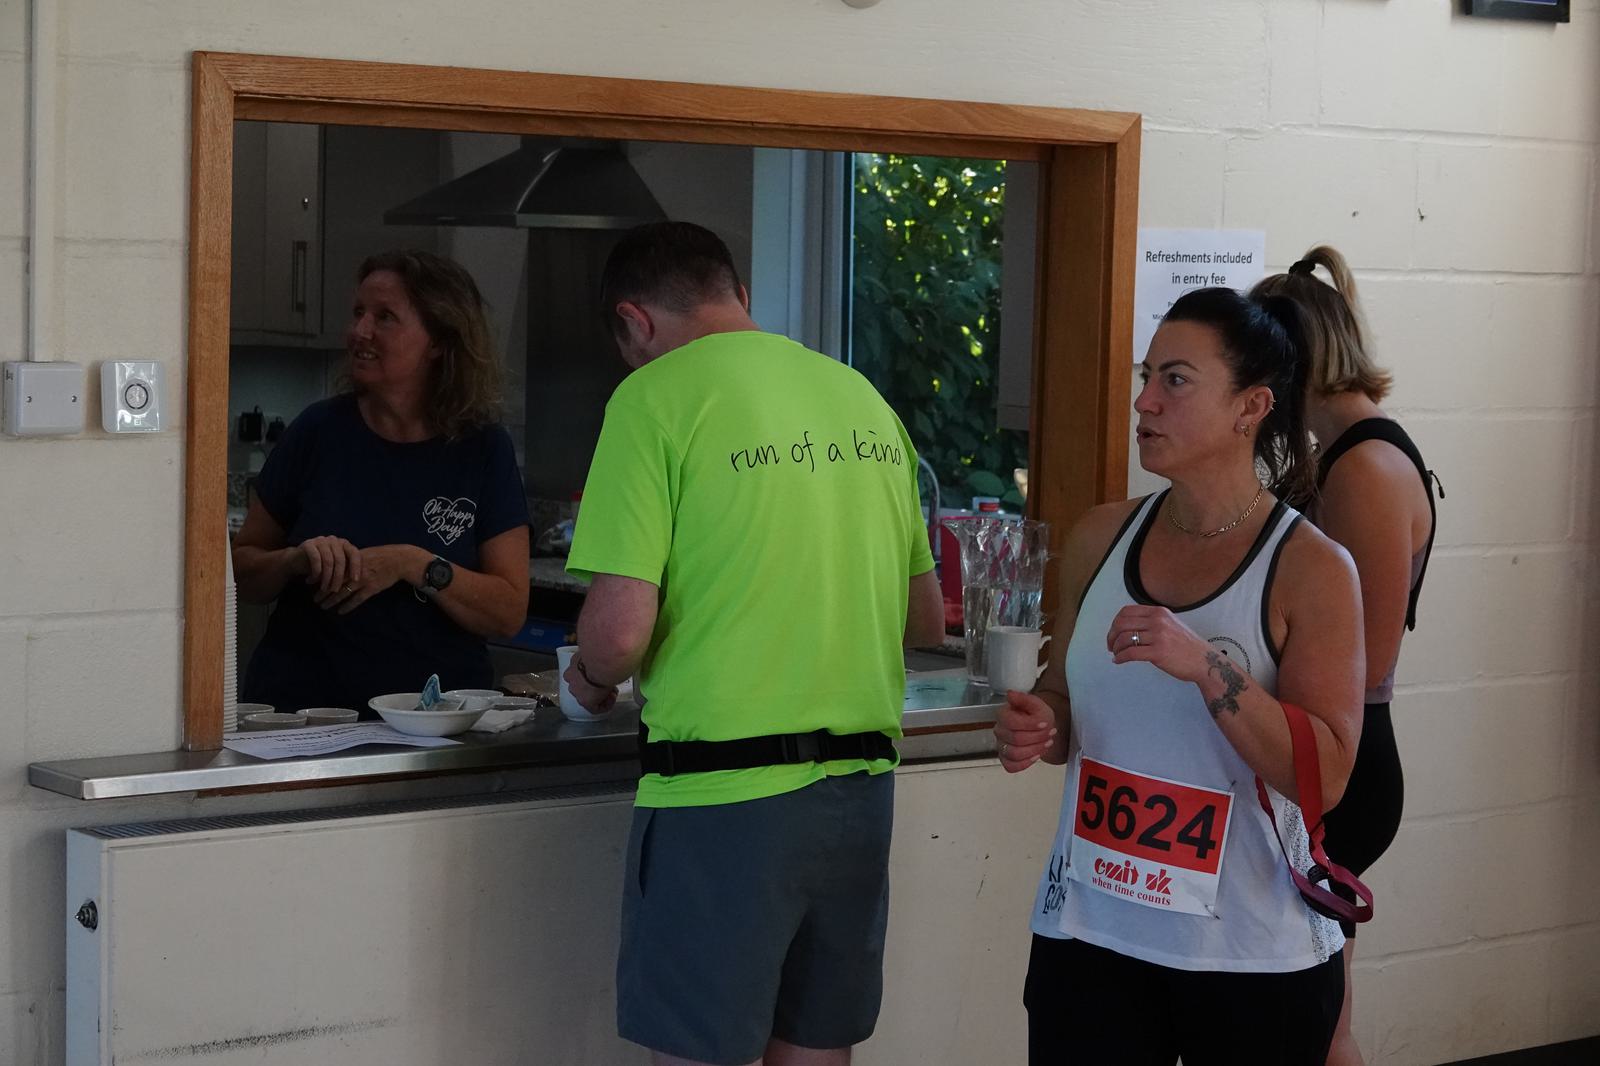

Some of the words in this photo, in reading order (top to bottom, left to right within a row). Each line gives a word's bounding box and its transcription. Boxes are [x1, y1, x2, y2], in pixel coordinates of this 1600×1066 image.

[1145, 250, 1211, 264] Refreshments
[1213, 251, 1253, 264] included
[1172, 272, 1181, 285] in
[1183, 274, 1209, 287] entry
[1211, 272, 1226, 285] fee
[730, 444, 780, 473] run
[791, 430, 814, 473] of
[828, 443, 845, 463] a
[853, 429, 902, 466] kind
[424, 498, 442, 516] Oh
[441, 503, 475, 528] Happy
[427, 515, 465, 540] Days
[1080, 774, 1217, 860] 5624
[1091, 876, 1112, 890] when
[1114, 883, 1135, 897] time
[1137, 891, 1172, 906] counts
